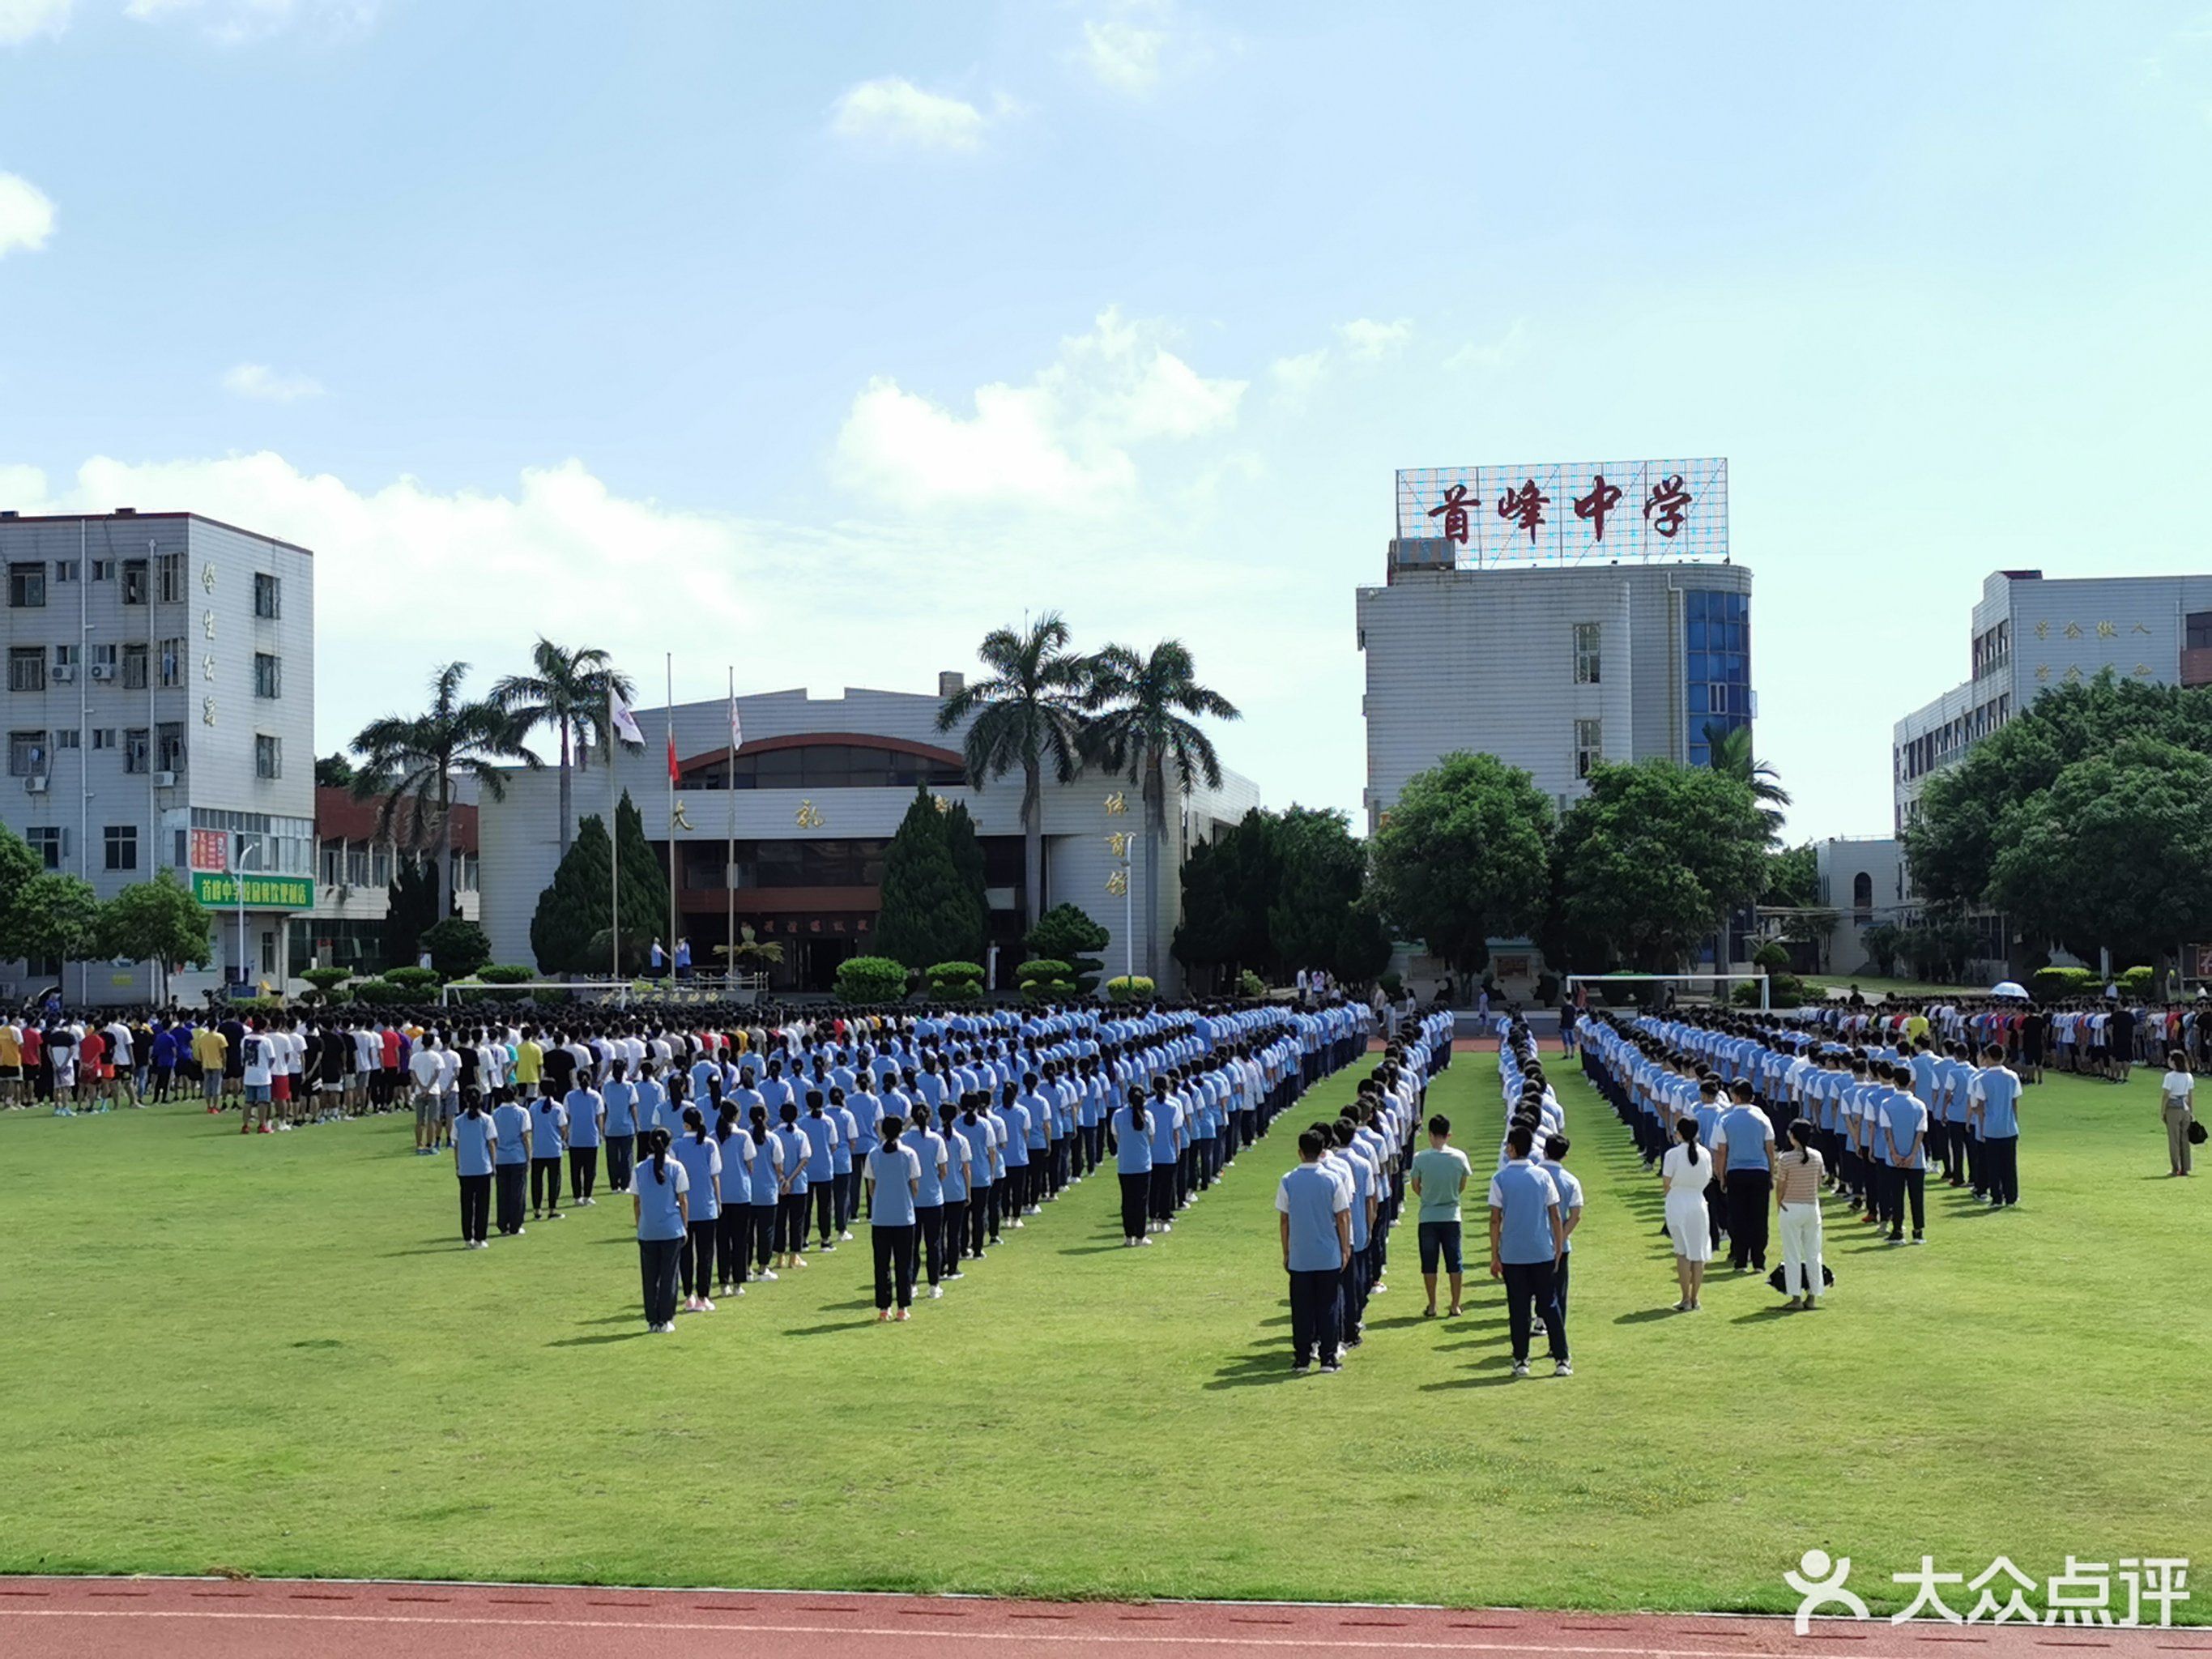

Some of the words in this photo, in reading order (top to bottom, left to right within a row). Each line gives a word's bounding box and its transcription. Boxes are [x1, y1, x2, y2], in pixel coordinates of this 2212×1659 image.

[1428, 475, 1692, 544] 首峰中学
[1103, 791, 1130, 898] 体育馆
